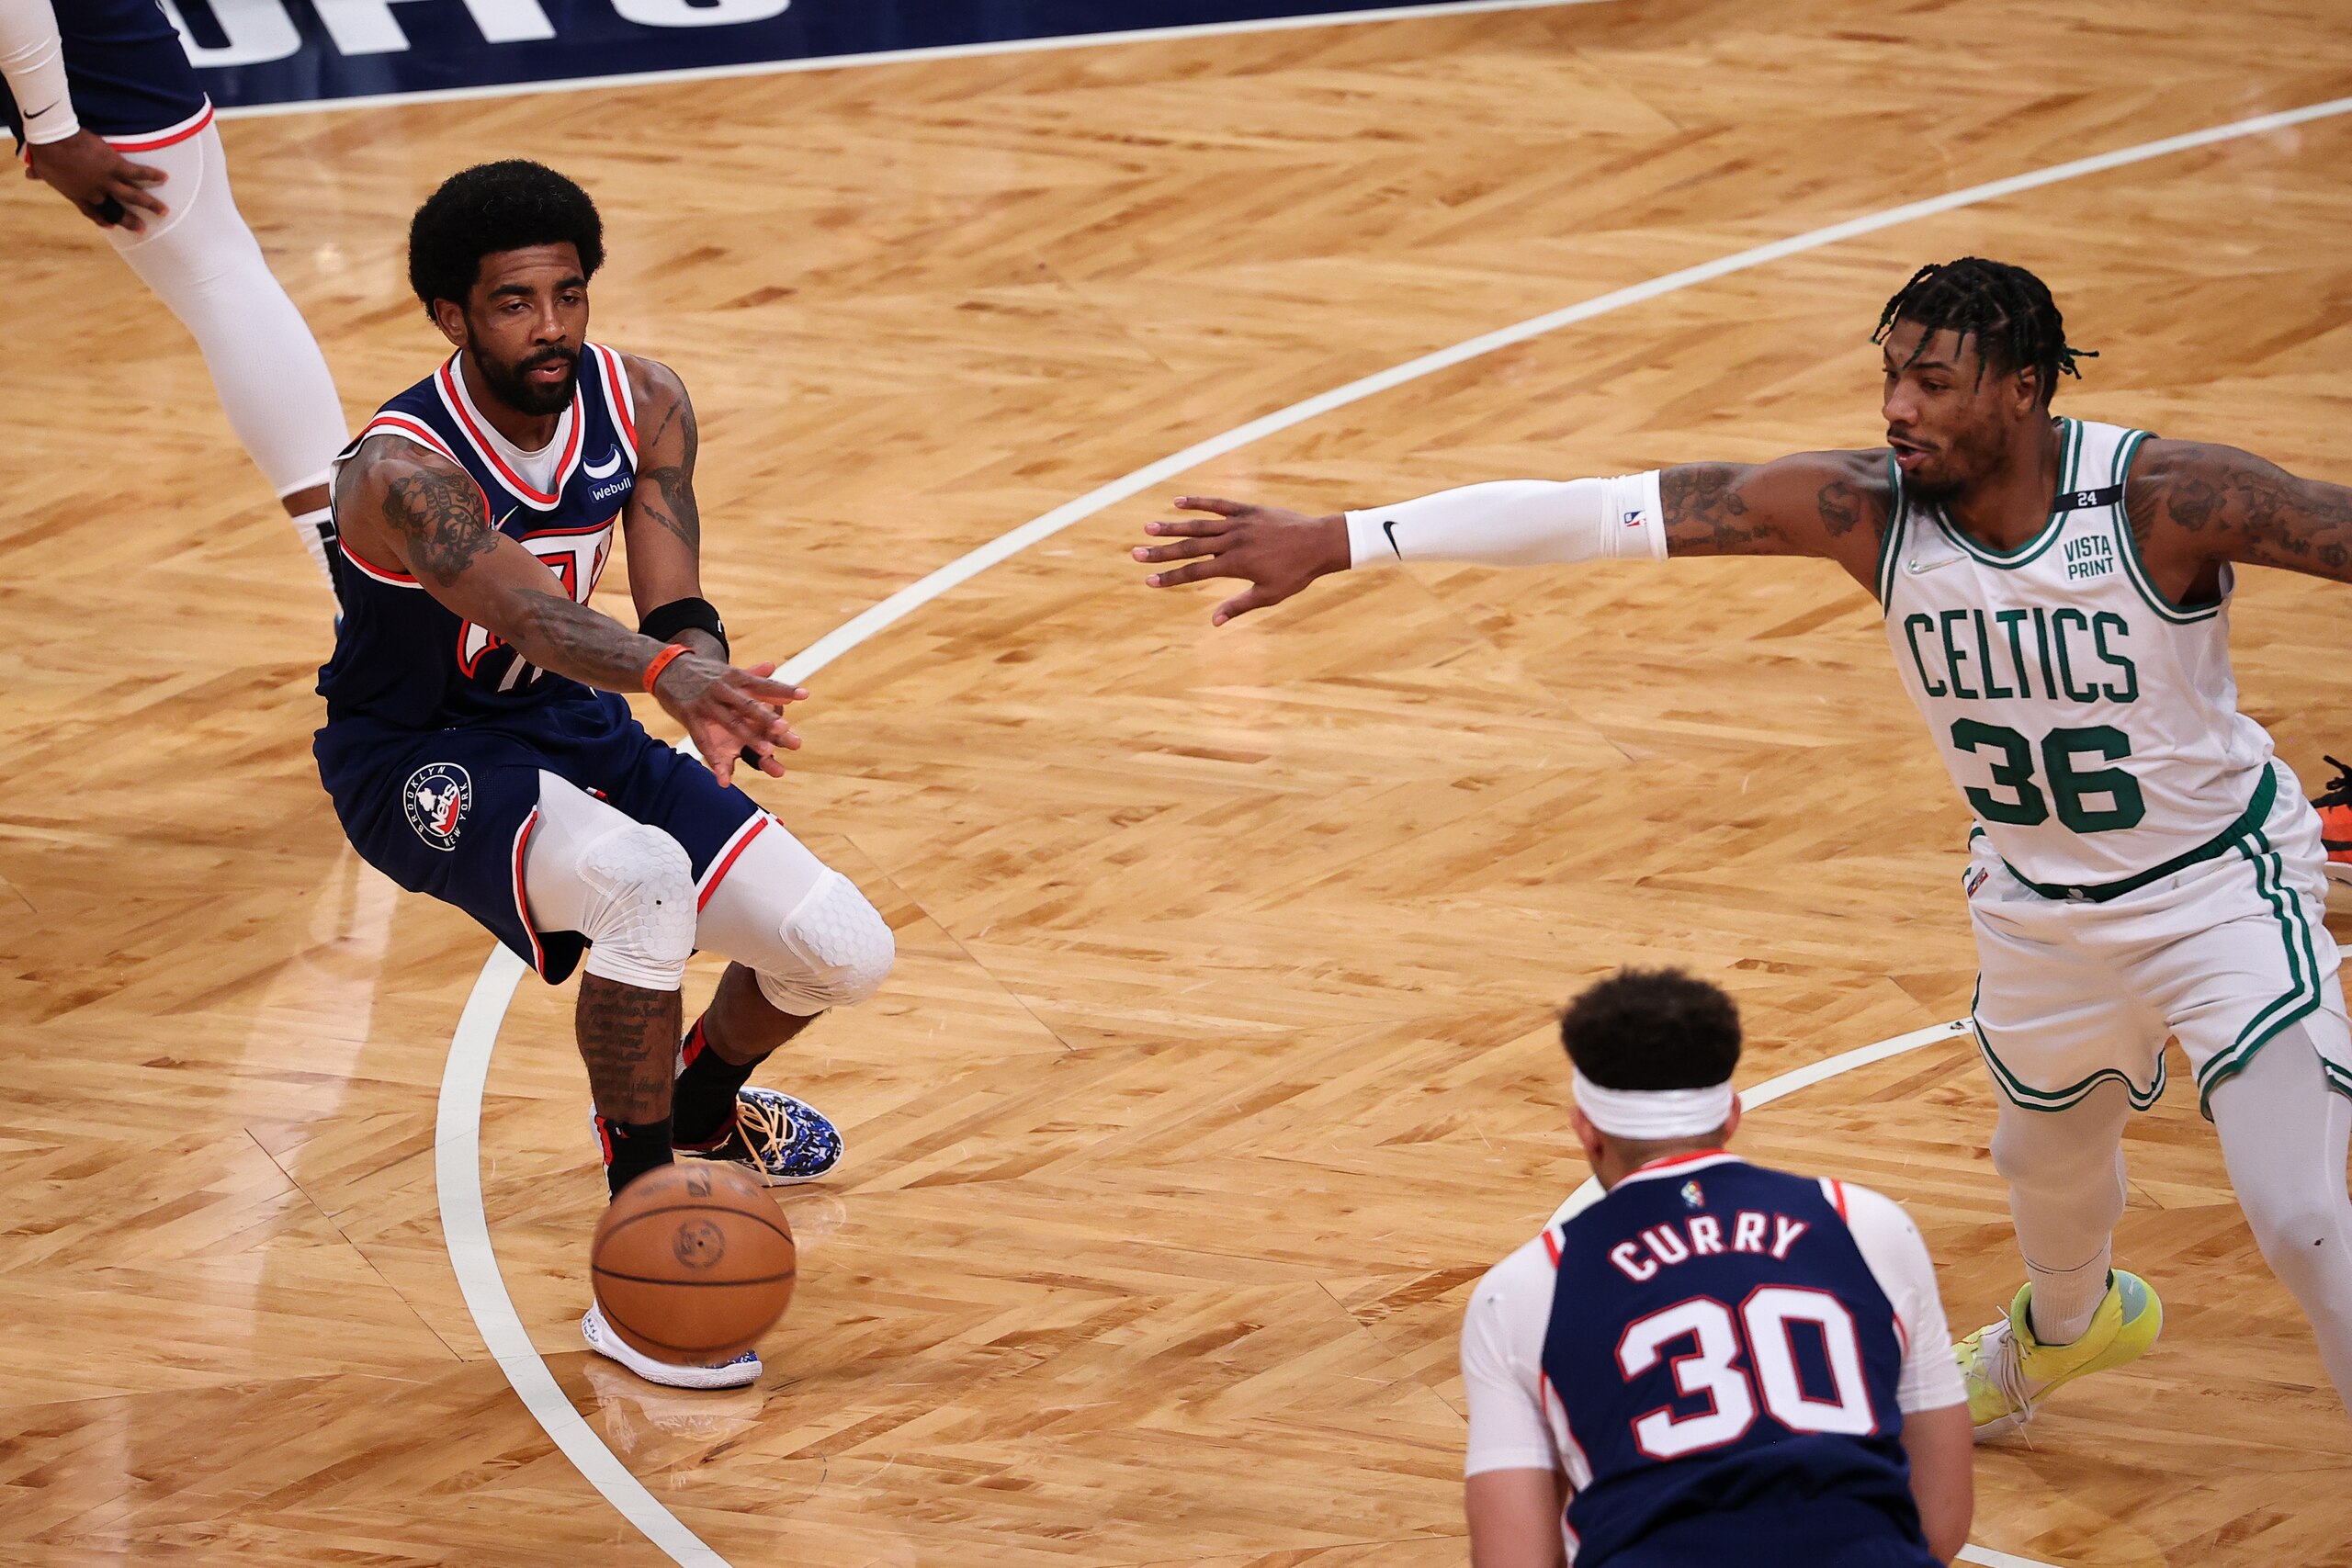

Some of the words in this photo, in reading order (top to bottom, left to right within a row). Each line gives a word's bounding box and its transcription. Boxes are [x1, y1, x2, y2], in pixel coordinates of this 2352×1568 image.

[593, 477, 632, 501] Webull
[2077, 492, 2098, 506] 24
[2064, 535, 2111, 561] VISTA
[2067, 558, 2114, 580] PRINT
[1904, 607, 2139, 704] CELTICS
[407, 765, 446, 832] BROOKLYN
[1951, 717, 2146, 834] 36
[444, 827, 461, 847] NEW
[1608, 1209, 1811, 1284] CURRY
[1614, 1282, 1880, 1461] 30
